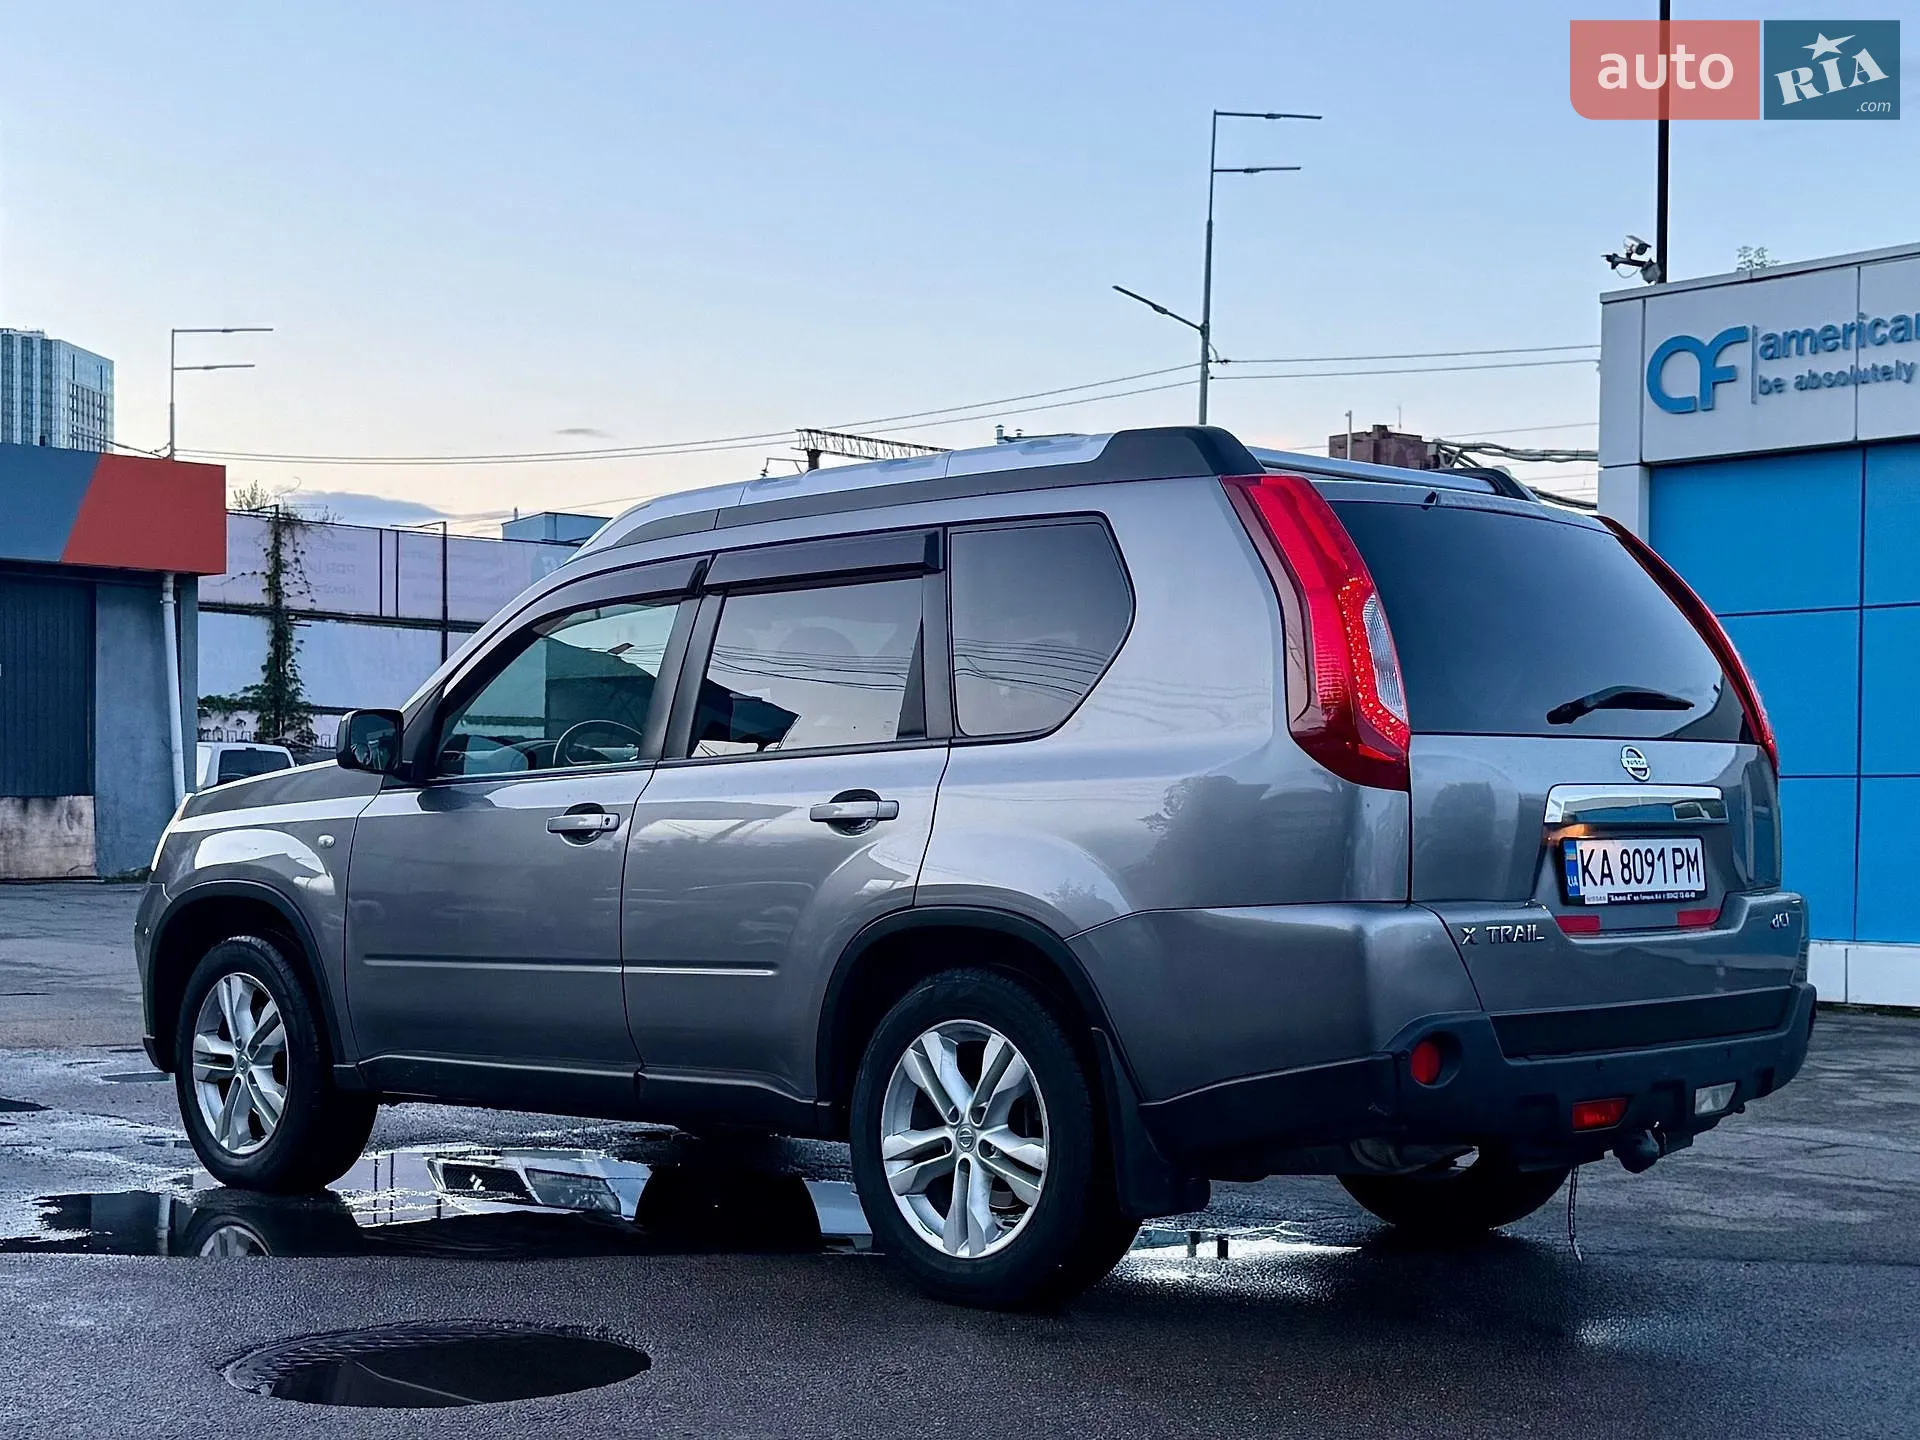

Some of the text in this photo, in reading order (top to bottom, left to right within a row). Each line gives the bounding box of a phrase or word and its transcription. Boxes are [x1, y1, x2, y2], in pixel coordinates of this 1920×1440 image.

[1759, 311, 1920, 361] america
[1759, 359, 1916, 395] be absolutely
[1567, 875, 1579, 887] UA
[1580, 846, 1700, 887] KA 8091 PM
[1461, 924, 1545, 945] X TRAIL
